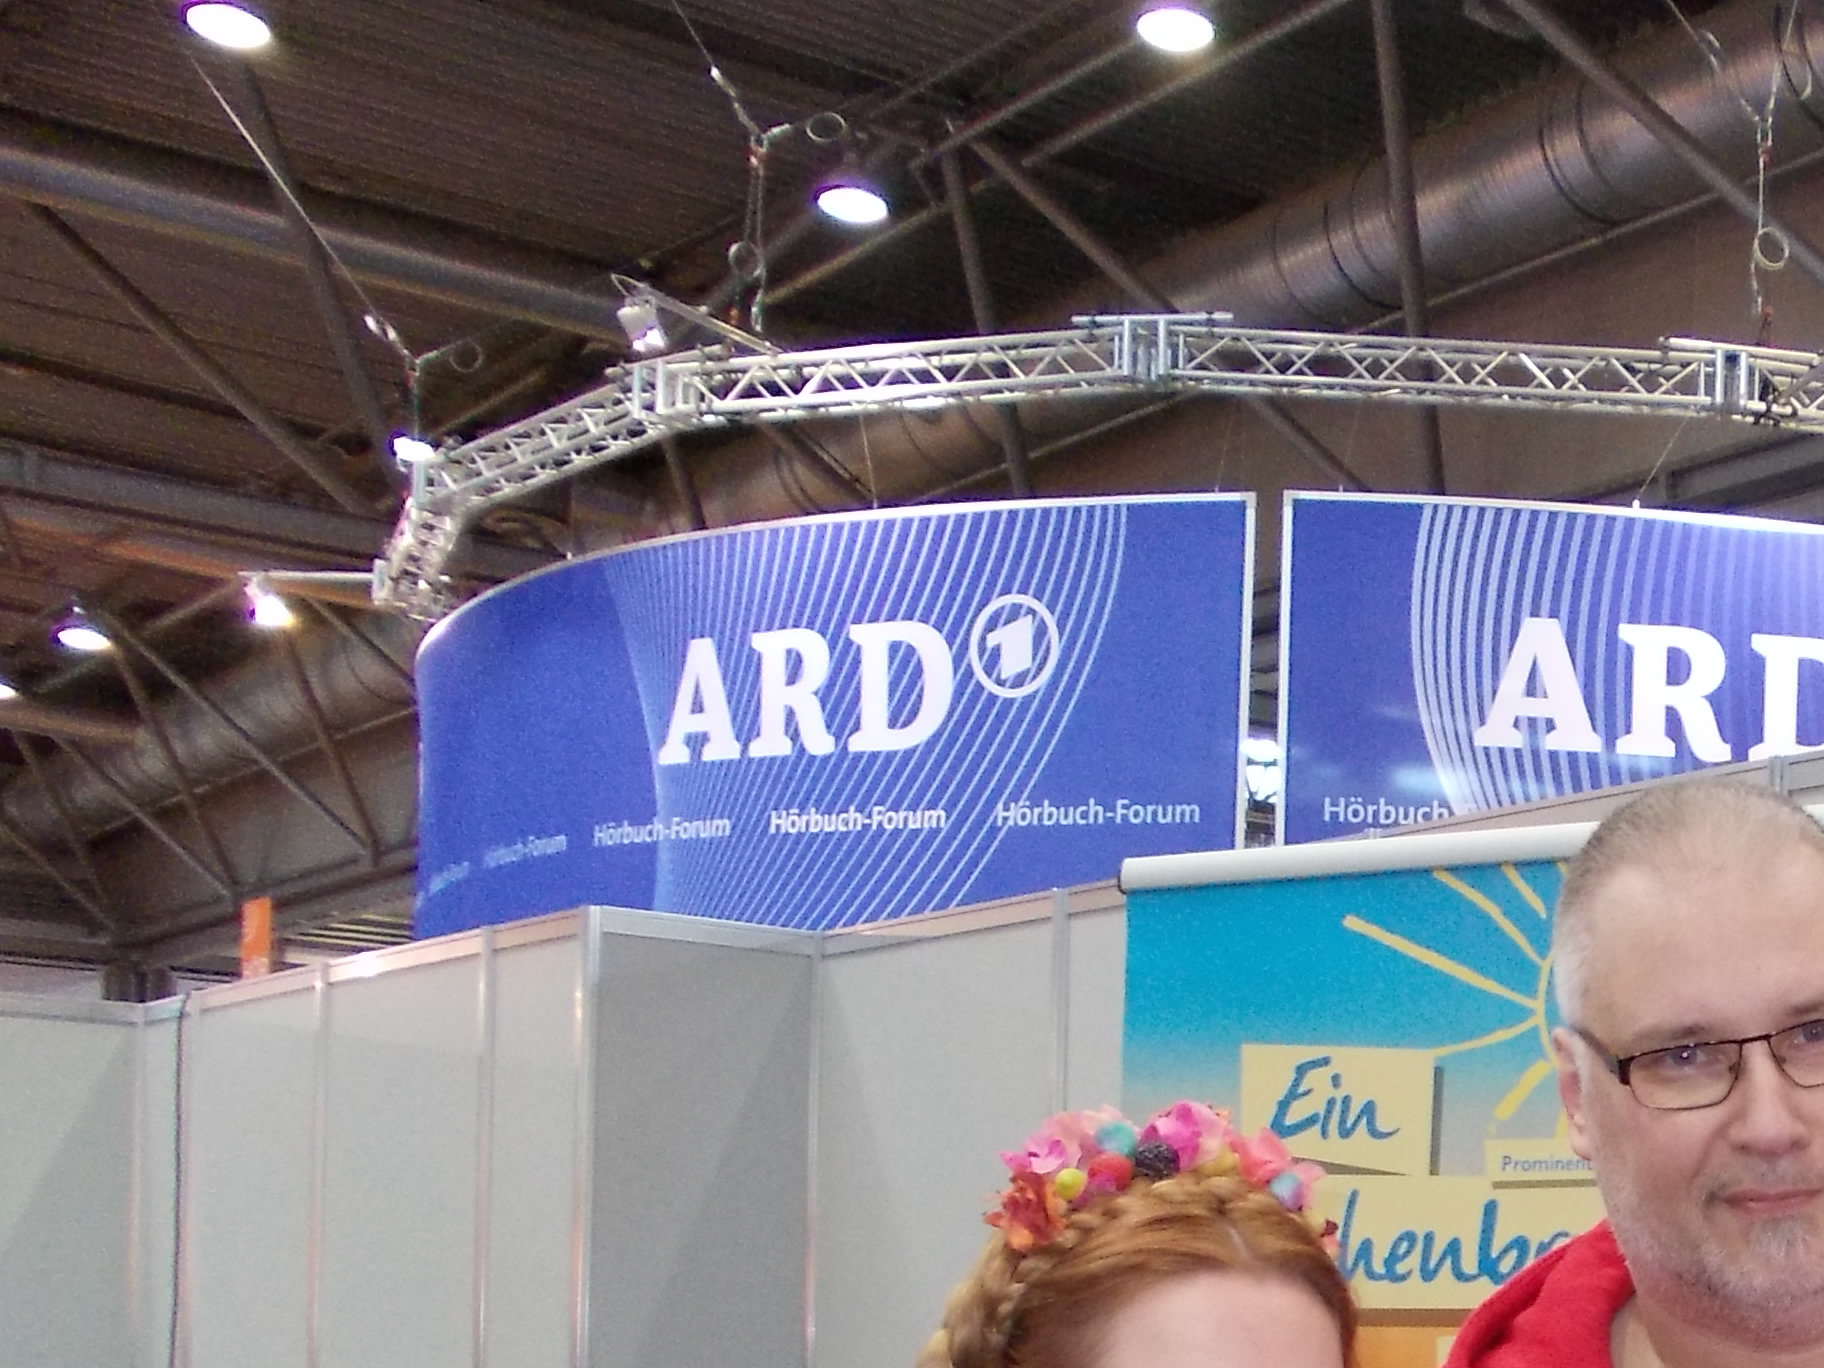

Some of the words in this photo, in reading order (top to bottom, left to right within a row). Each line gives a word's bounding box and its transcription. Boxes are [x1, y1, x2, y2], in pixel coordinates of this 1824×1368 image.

[659, 620, 954, 766] ARD
[769, 806, 947, 834] Hörbuch-Forum
[997, 797, 1202, 829] Hörbuch-Forum
[594, 816, 731, 847] Hörbuch-Forum
[1269, 1055, 1401, 1140] Ein
